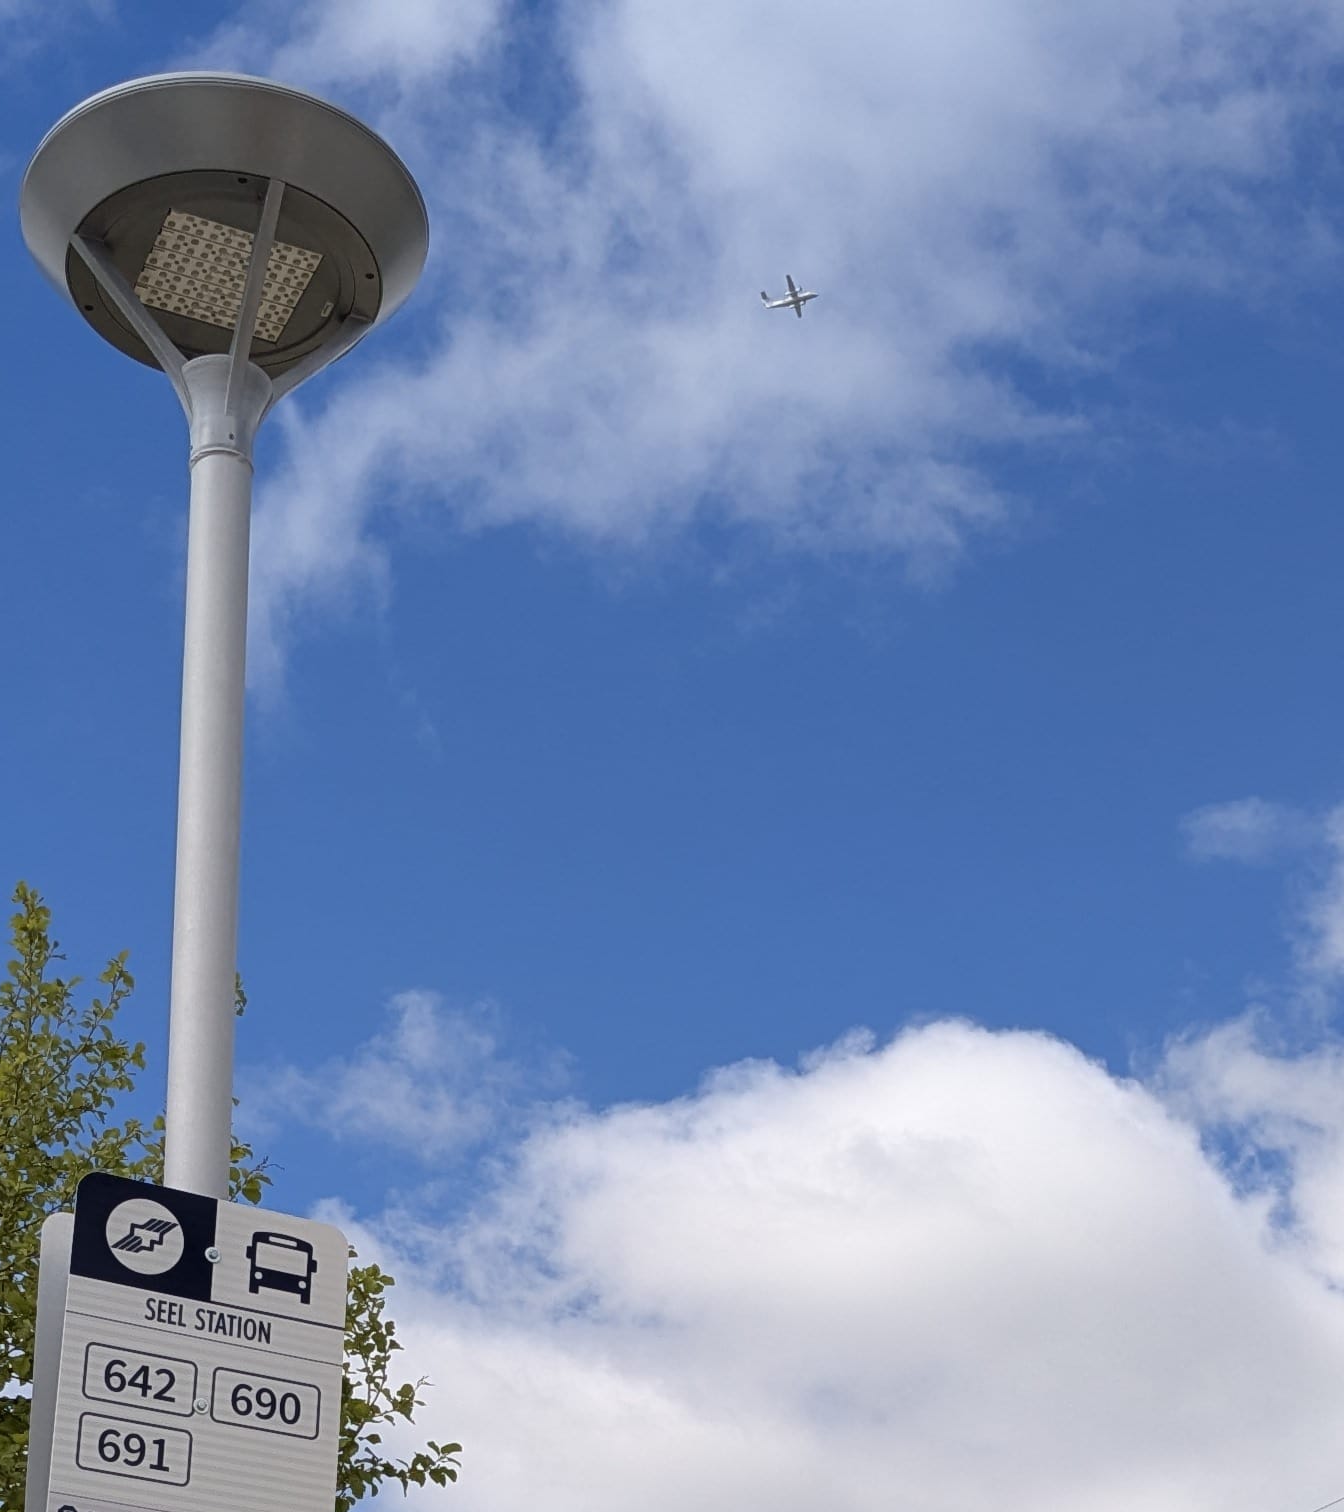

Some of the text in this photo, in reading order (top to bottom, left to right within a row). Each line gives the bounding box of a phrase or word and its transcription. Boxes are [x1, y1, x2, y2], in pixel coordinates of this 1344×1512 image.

[144, 1298, 272, 1344] SEEL STATION
[104, 1359, 176, 1403] 642
[231, 1383, 301, 1425] 690
[98, 1428, 170, 1472] 691
